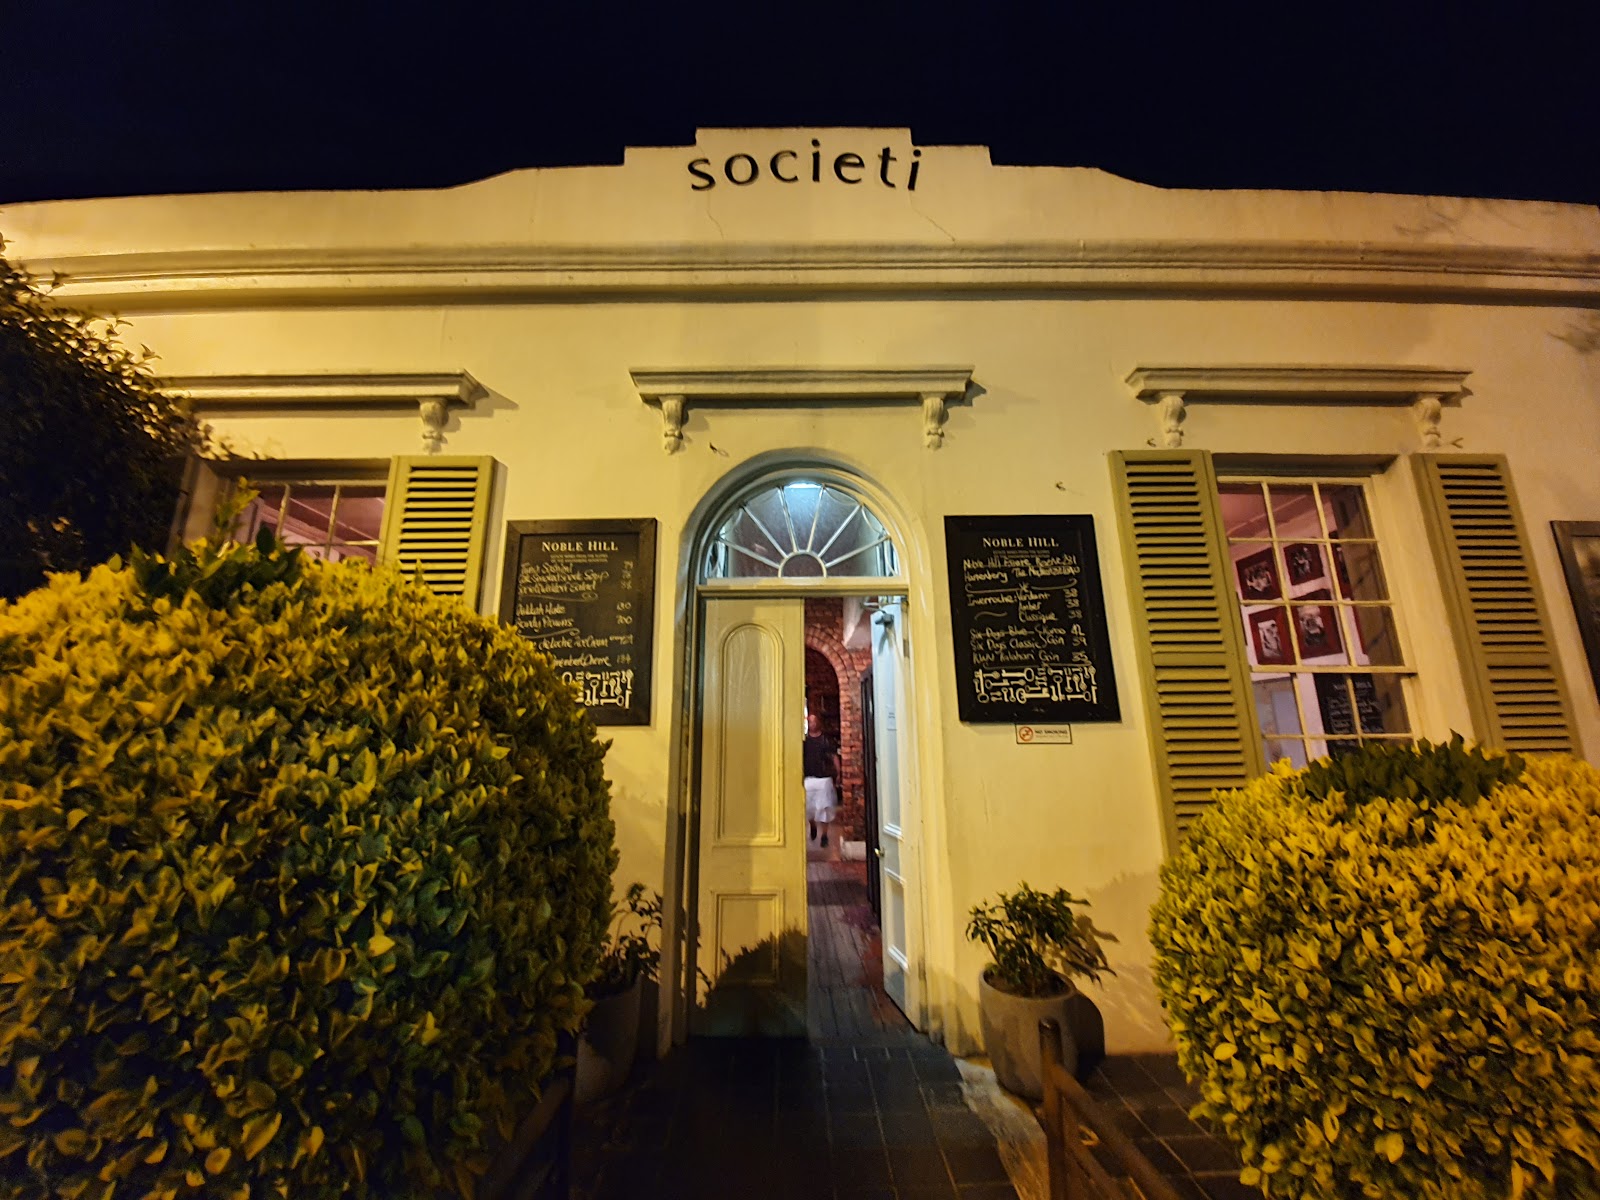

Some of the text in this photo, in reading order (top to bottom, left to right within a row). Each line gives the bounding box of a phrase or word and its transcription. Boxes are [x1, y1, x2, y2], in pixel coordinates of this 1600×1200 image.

[687, 138, 922, 192] societi
[542, 541, 618, 552] NOBLE HILL
[982, 537, 1059, 548] NOBLE HILL
